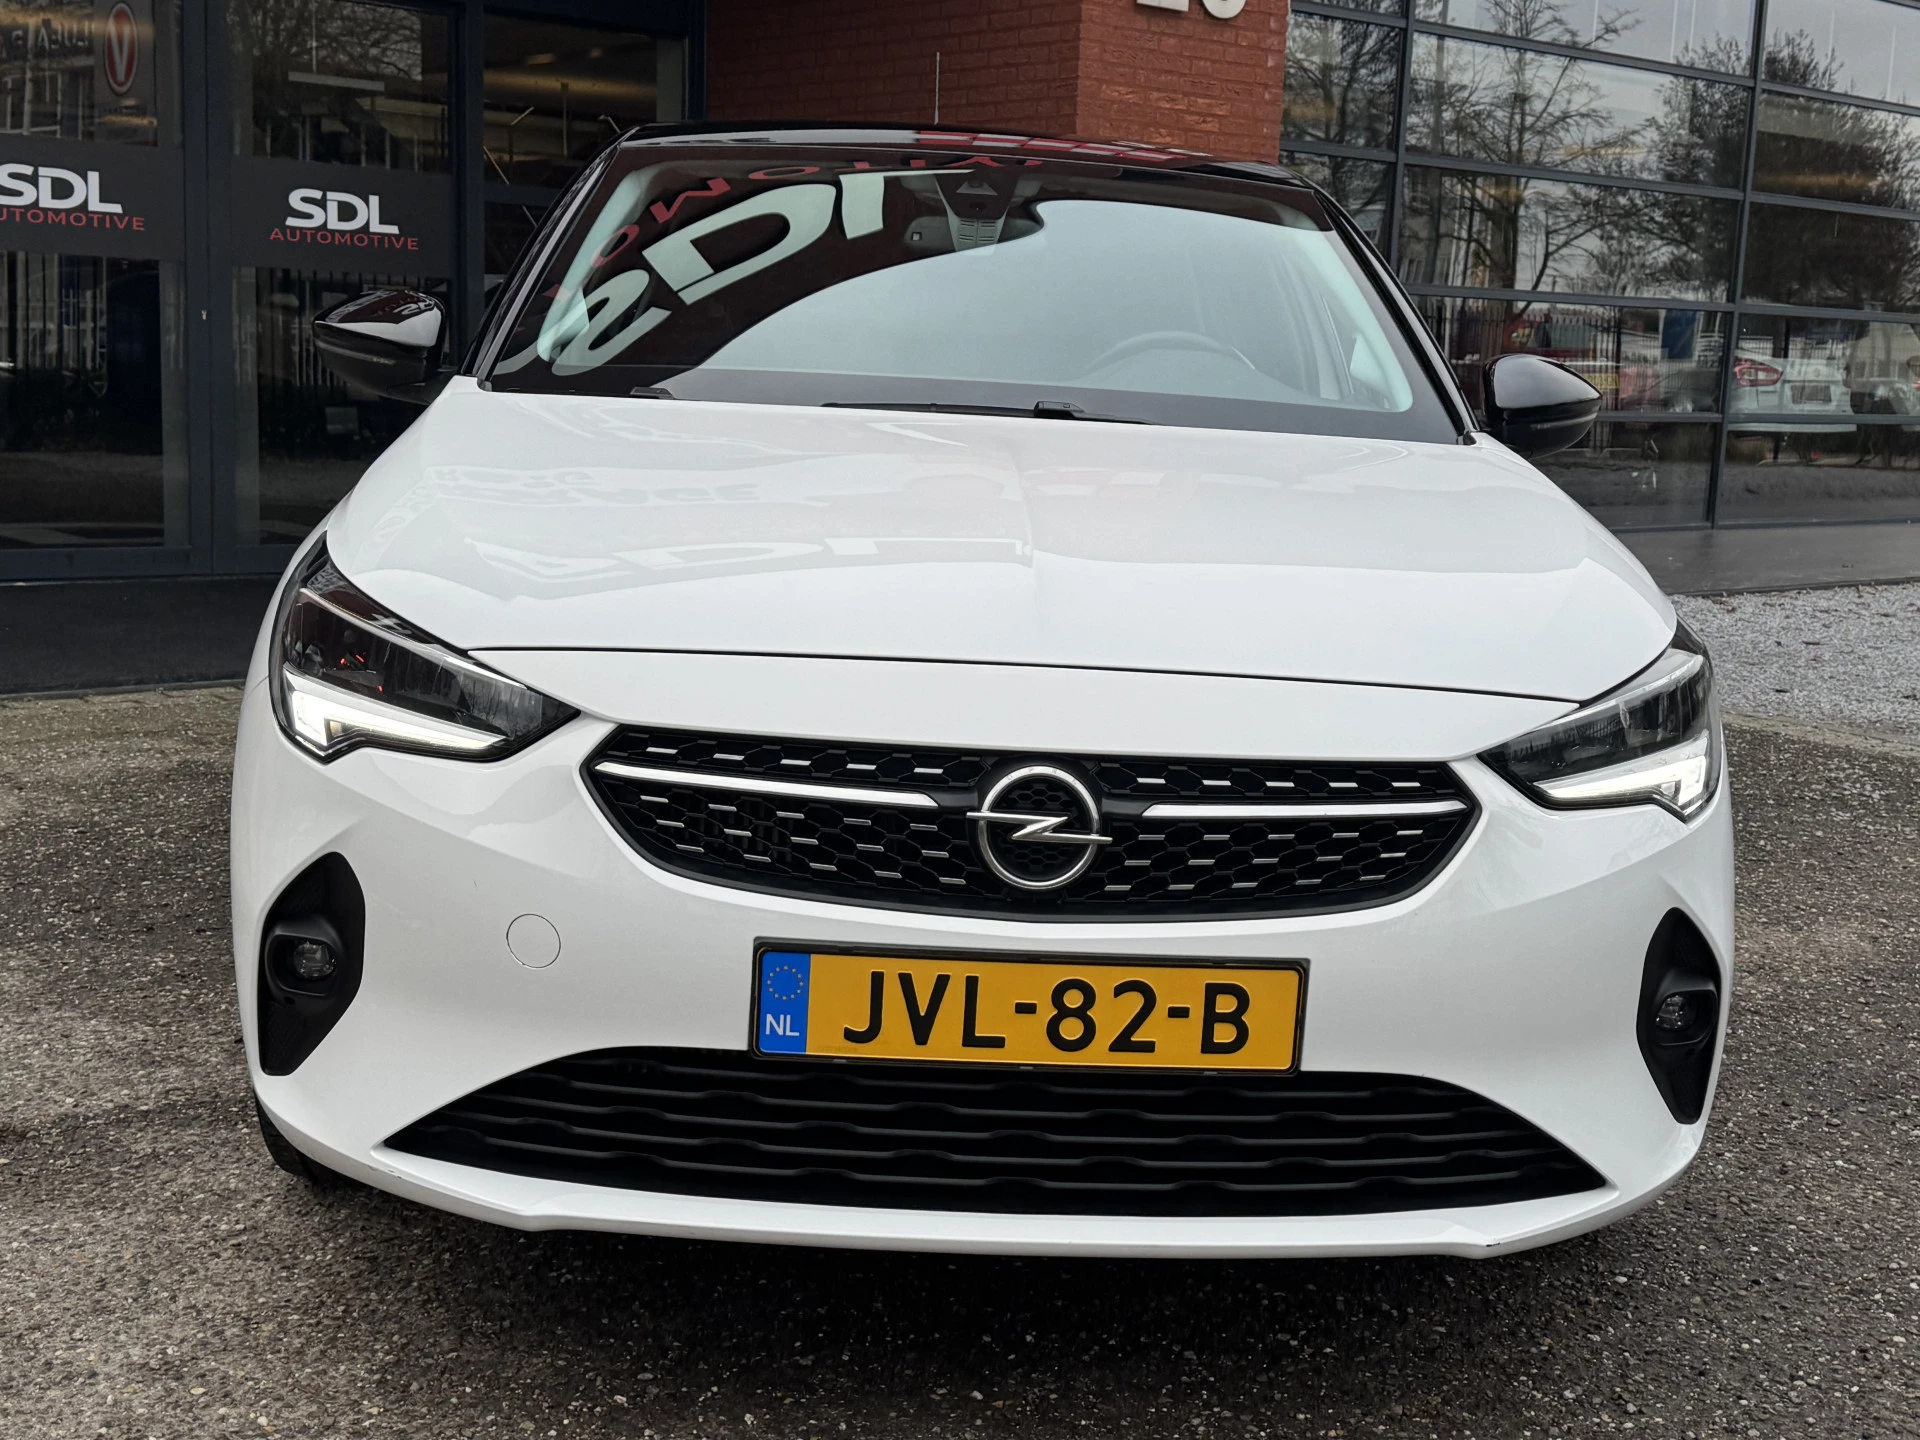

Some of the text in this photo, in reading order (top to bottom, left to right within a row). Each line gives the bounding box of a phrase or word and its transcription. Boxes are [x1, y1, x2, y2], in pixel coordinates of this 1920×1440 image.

[0, 163, 123, 214] SDL
[0, 207, 146, 231] UTOMOTIVE
[285, 188, 400, 235] SDL
[269, 227, 419, 251] AUTOMOTIVE
[765, 1013, 800, 1037] NL
[843, 969, 1250, 1055] JVL-82-B
